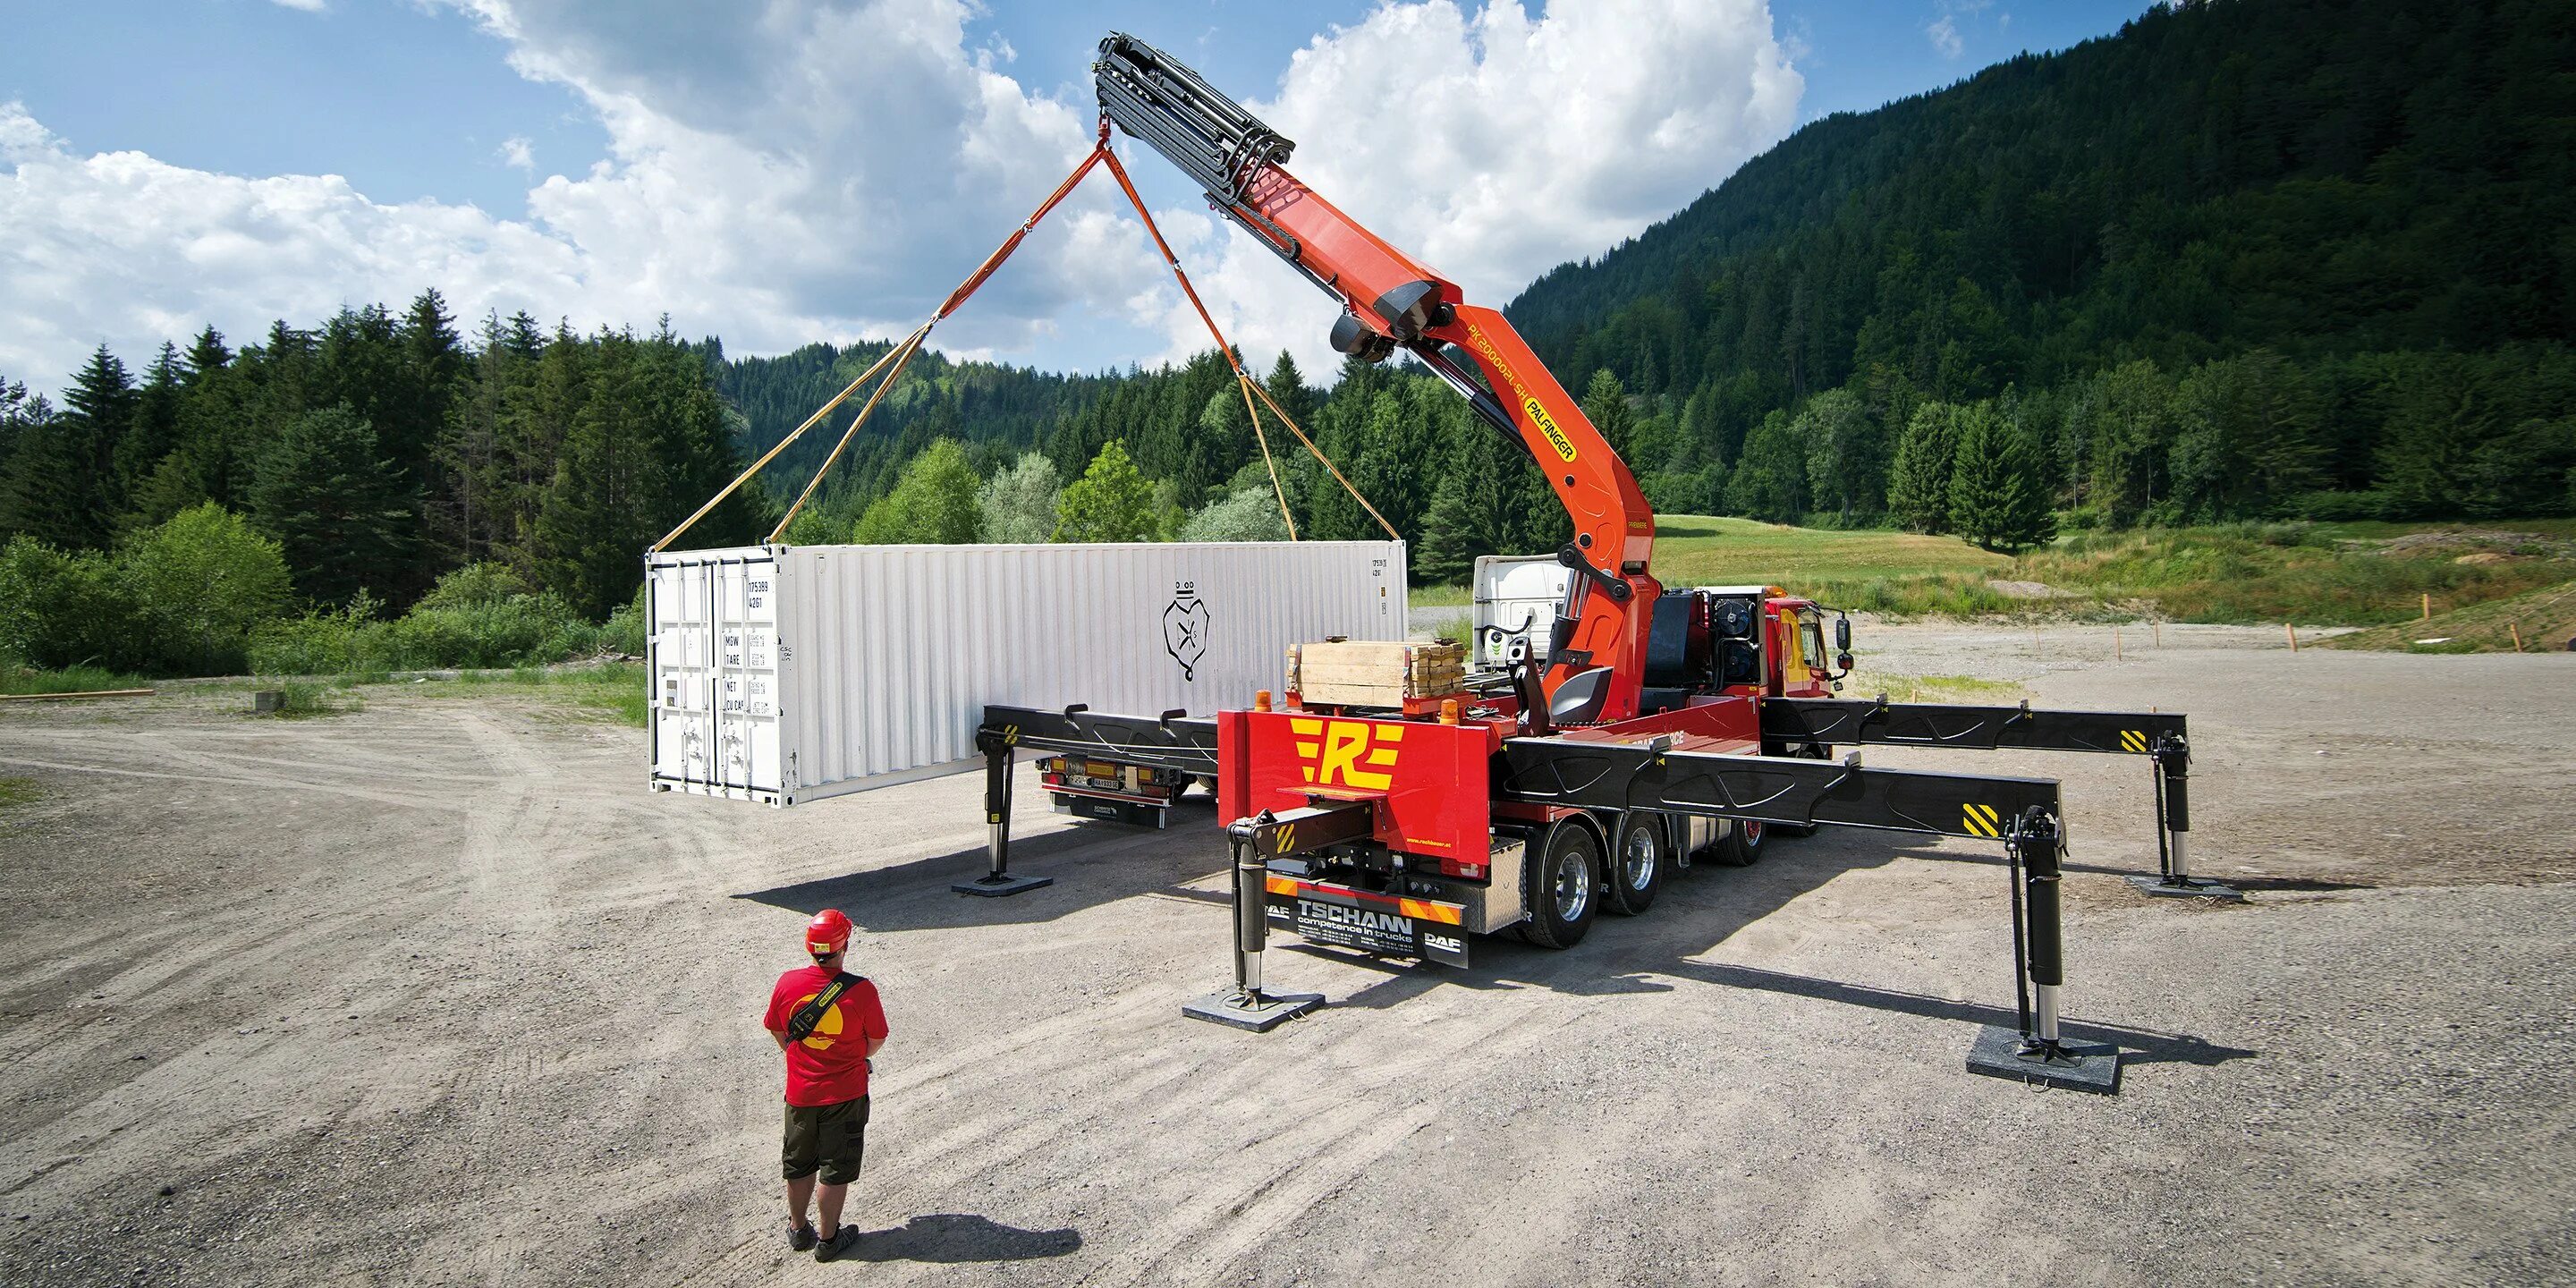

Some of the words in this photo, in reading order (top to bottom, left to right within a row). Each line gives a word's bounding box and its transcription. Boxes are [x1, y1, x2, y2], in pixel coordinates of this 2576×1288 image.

[1467, 324, 1481, 340] PK
[1526, 401, 1573, 459] PALFINGER
[726, 654, 740, 665] TARE
[726, 682, 736, 692] NET
[1298, 899, 1412, 935] TSCHANN
[1298, 917, 1362, 934] competence
[1364, 927, 1374, 936] in
[1374, 928, 1413, 943] trucks
[1424, 932, 1461, 950] DAF
